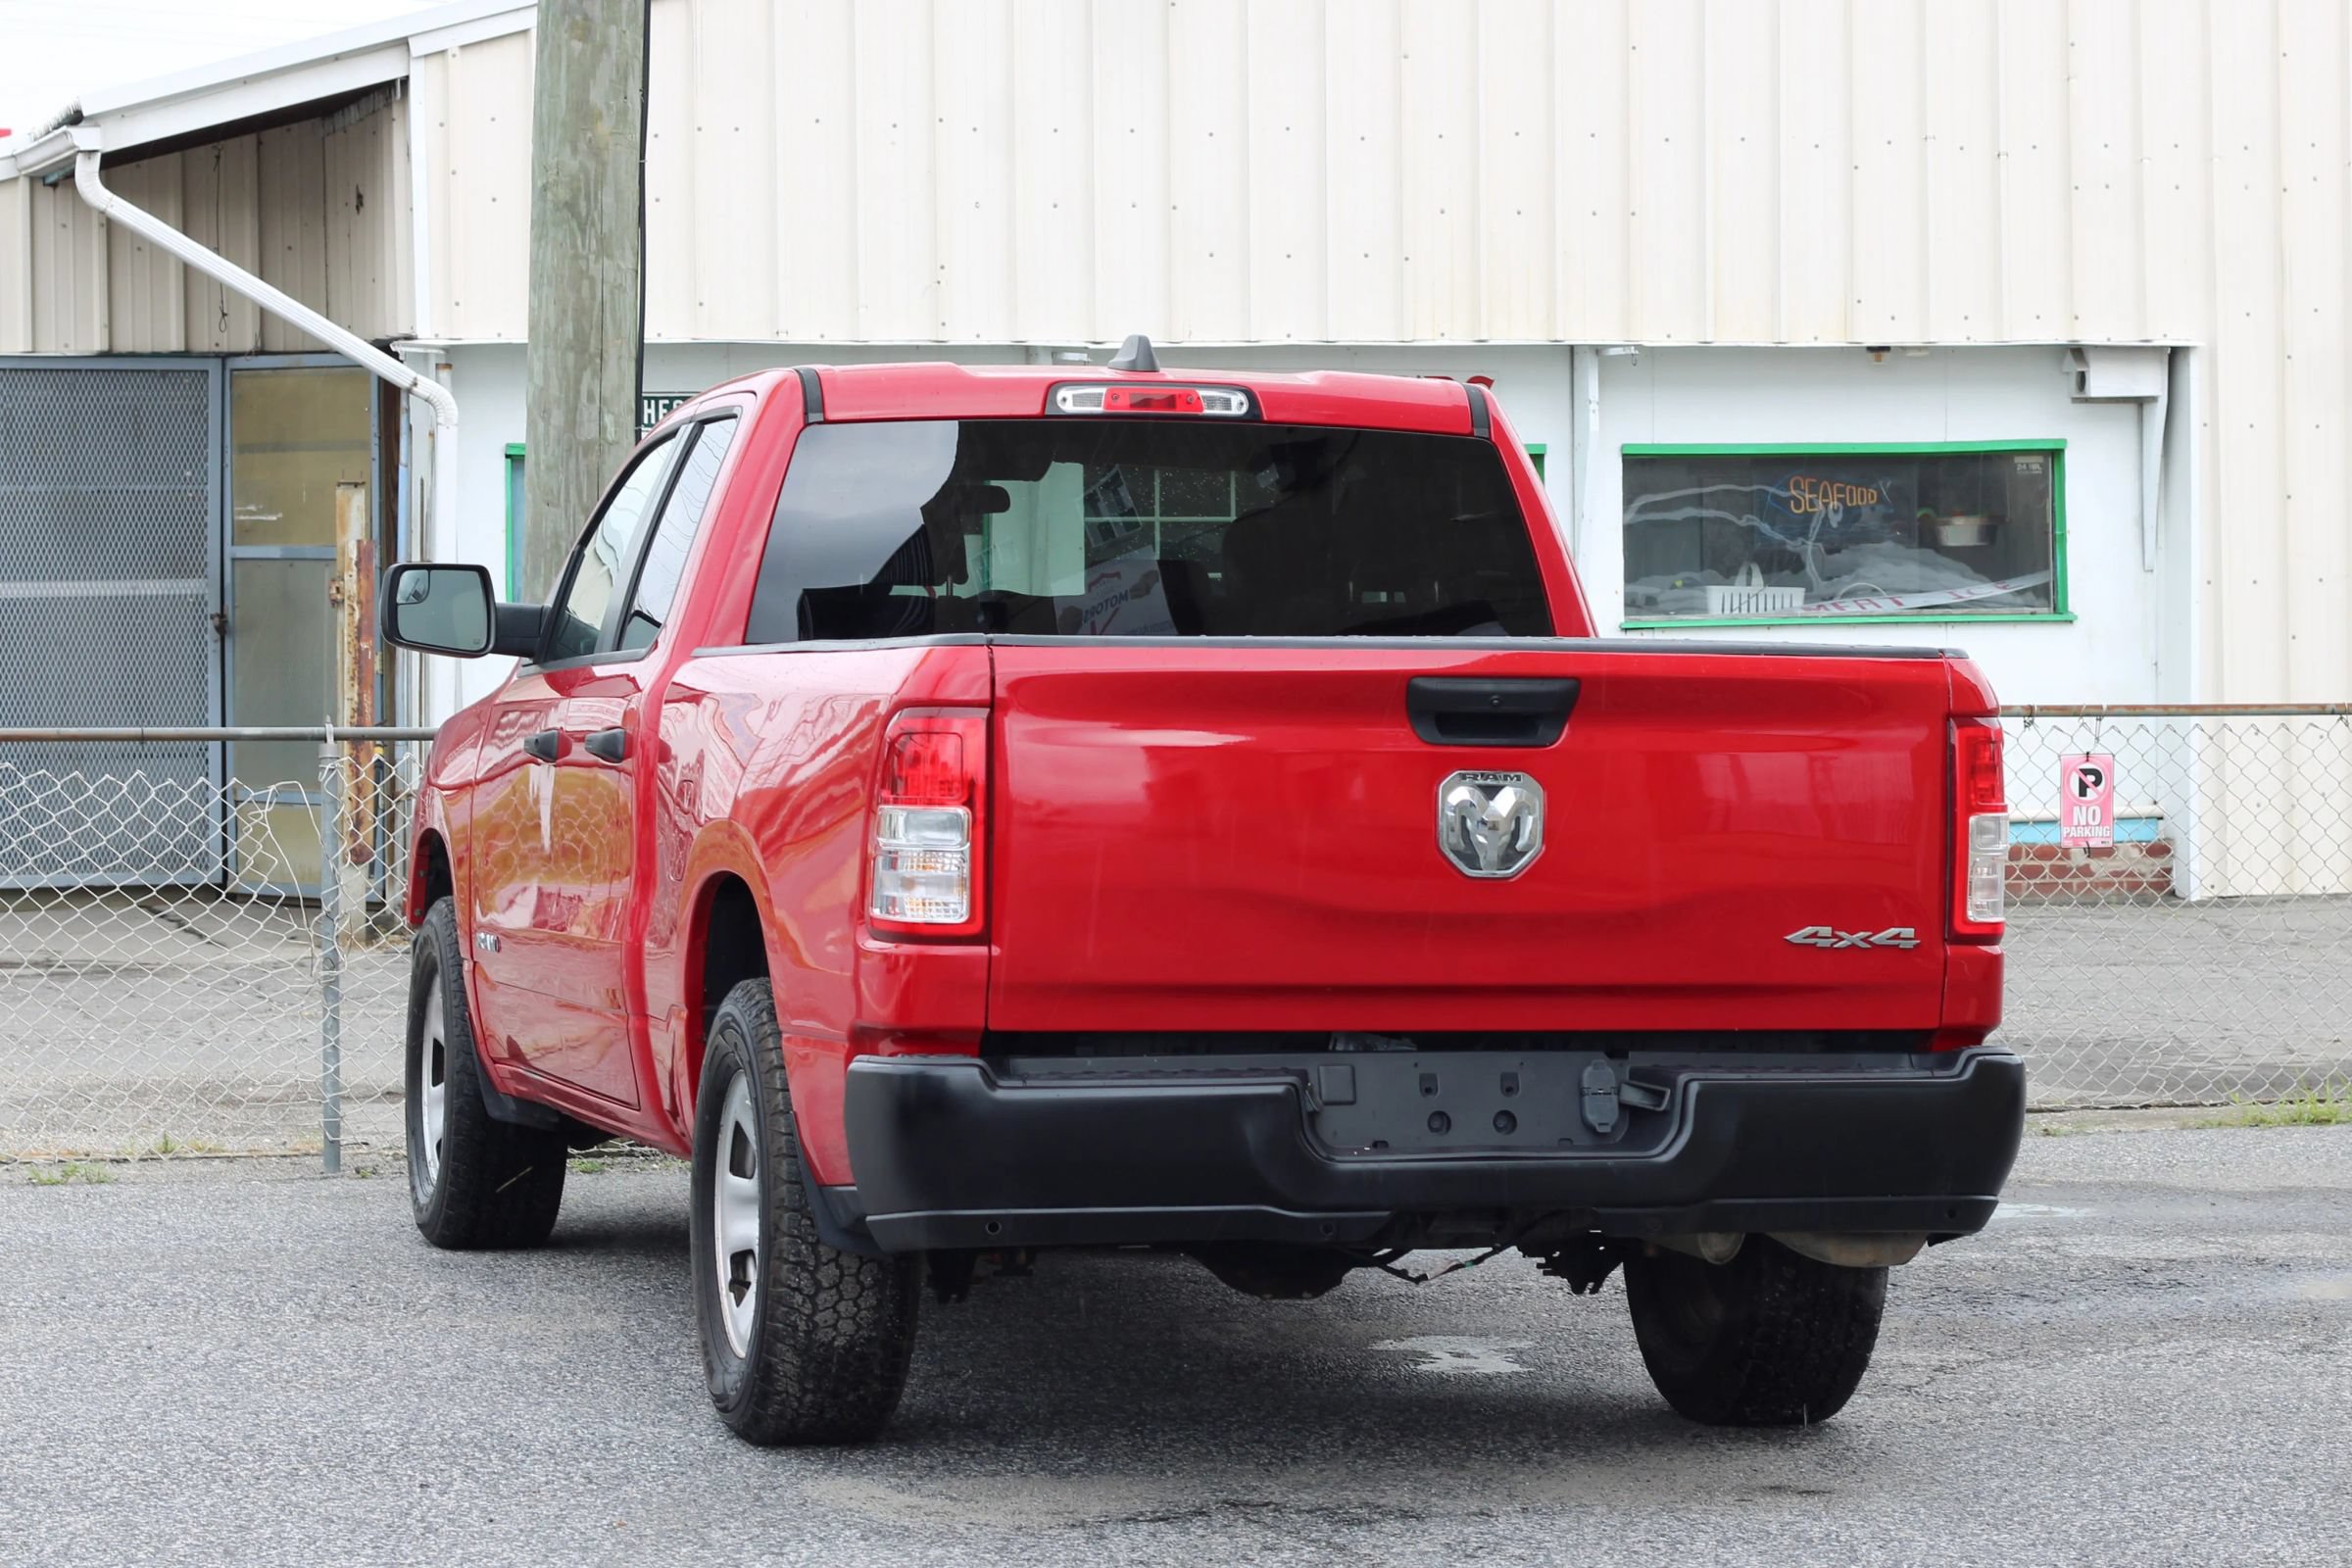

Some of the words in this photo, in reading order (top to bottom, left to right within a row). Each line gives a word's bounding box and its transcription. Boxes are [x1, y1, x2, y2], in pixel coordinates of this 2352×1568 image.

[1789, 475, 1878, 514] SEAFOOD
[1946, 581, 2013, 600] ICE
[1459, 772, 1523, 782] RAM
[2073, 806, 2101, 826] NO
[2063, 826, 2111, 838] PARKING
[1783, 926, 1921, 949] 4x4
